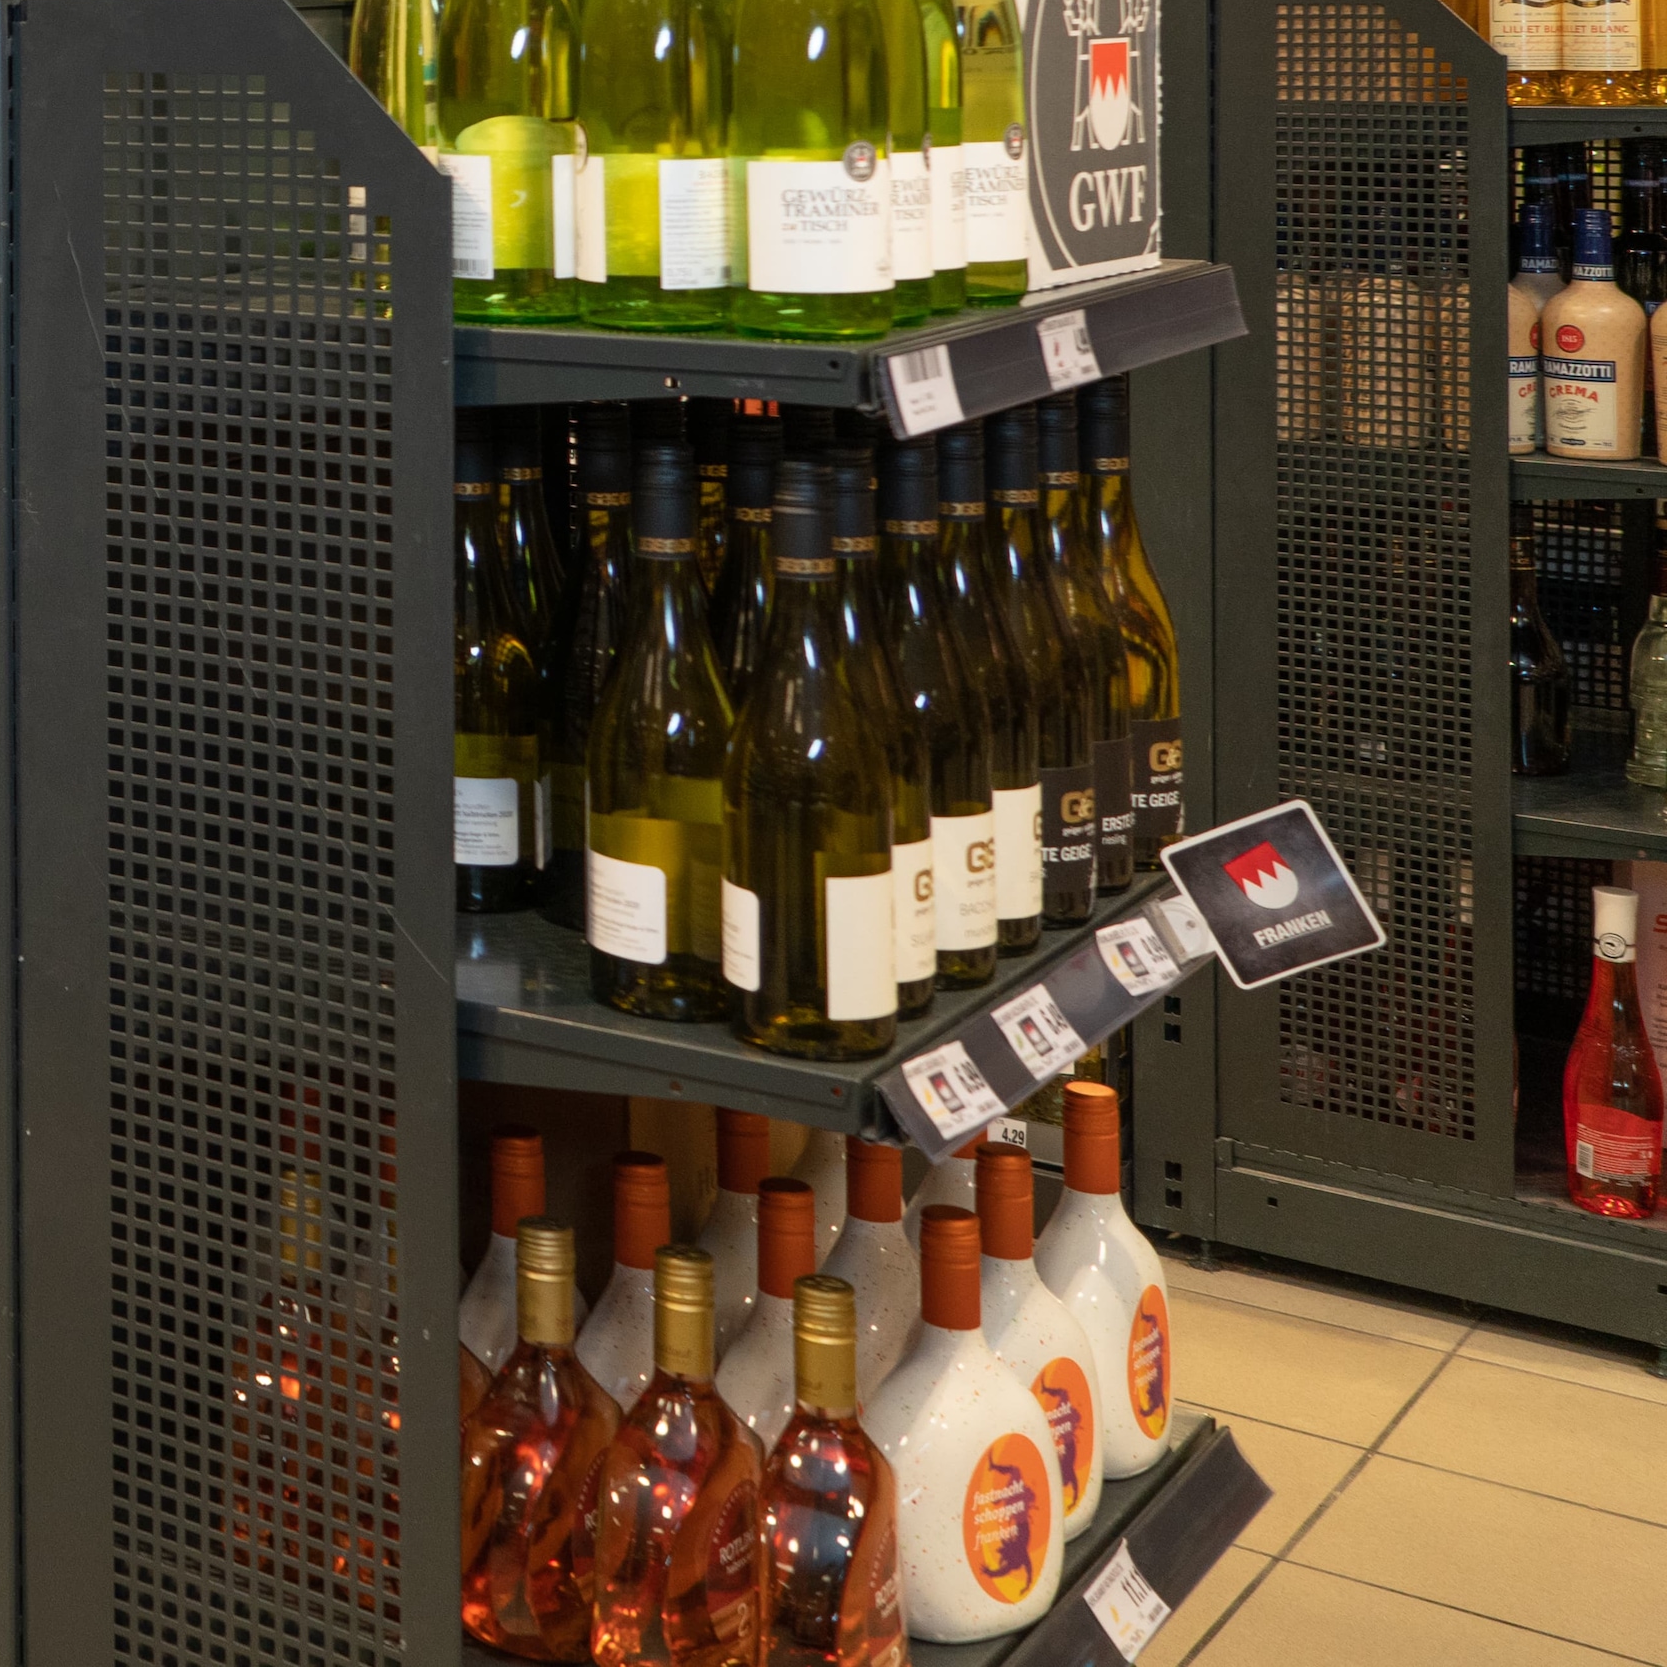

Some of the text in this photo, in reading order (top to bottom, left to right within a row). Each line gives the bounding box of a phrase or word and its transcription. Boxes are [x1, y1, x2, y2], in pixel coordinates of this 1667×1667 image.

[783, 201, 880, 217] TRAMINER
[1070, 164, 1147, 232] GWF
[1549, 384, 1599, 403] CREMA
[1149, 791, 1179, 808] GEIGE
[1060, 843, 1091, 861] GEIGE
[1253, 909, 1332, 948] FRANKEN
[1001, 1126, 1025, 1145] 4.29
[972, 1479, 1025, 1511] fastnacht
[974, 1499, 1025, 1525] schoppen
[974, 1523, 1019, 1552] franken
